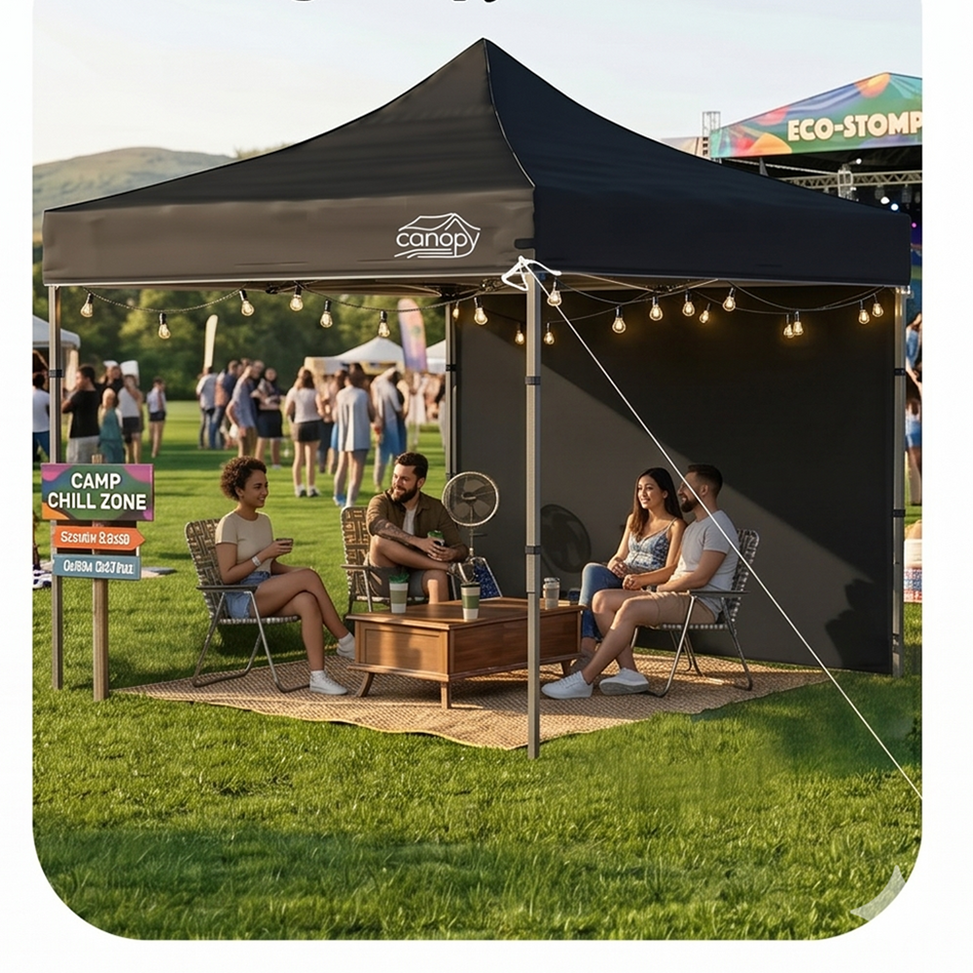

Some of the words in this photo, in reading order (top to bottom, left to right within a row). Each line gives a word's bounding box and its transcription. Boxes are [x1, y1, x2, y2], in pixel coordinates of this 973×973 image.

[787, 110, 923, 142] ECO-STOMP
[395, 231, 481, 259] canopy
[71, 472, 121, 490] CAMP
[47, 492, 96, 510] CHILL
[100, 493, 147, 511] ZONE
